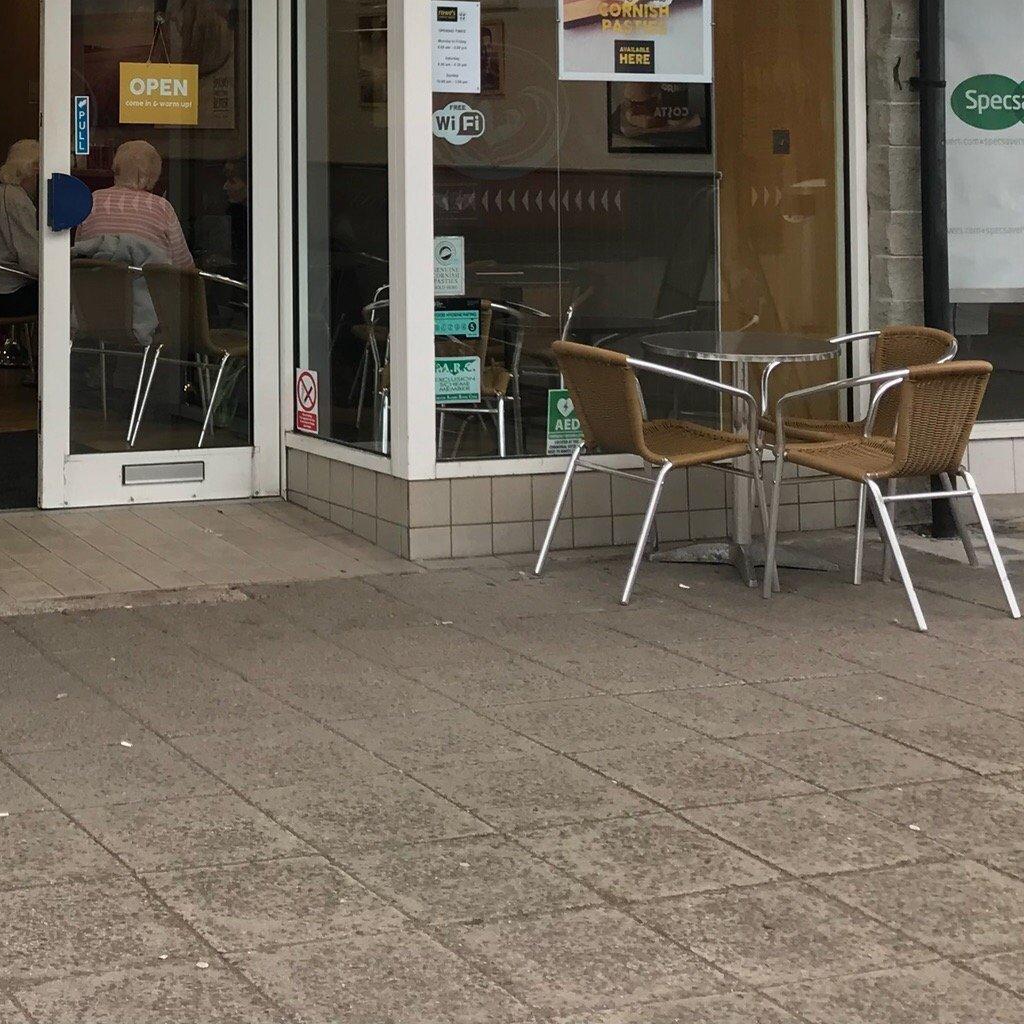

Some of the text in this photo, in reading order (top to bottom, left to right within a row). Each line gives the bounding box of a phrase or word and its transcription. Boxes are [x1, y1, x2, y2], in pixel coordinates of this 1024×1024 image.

[619, 53, 650, 64] HERE
[129, 78, 188, 96] OPEN
[555, 419, 580, 430] AED
